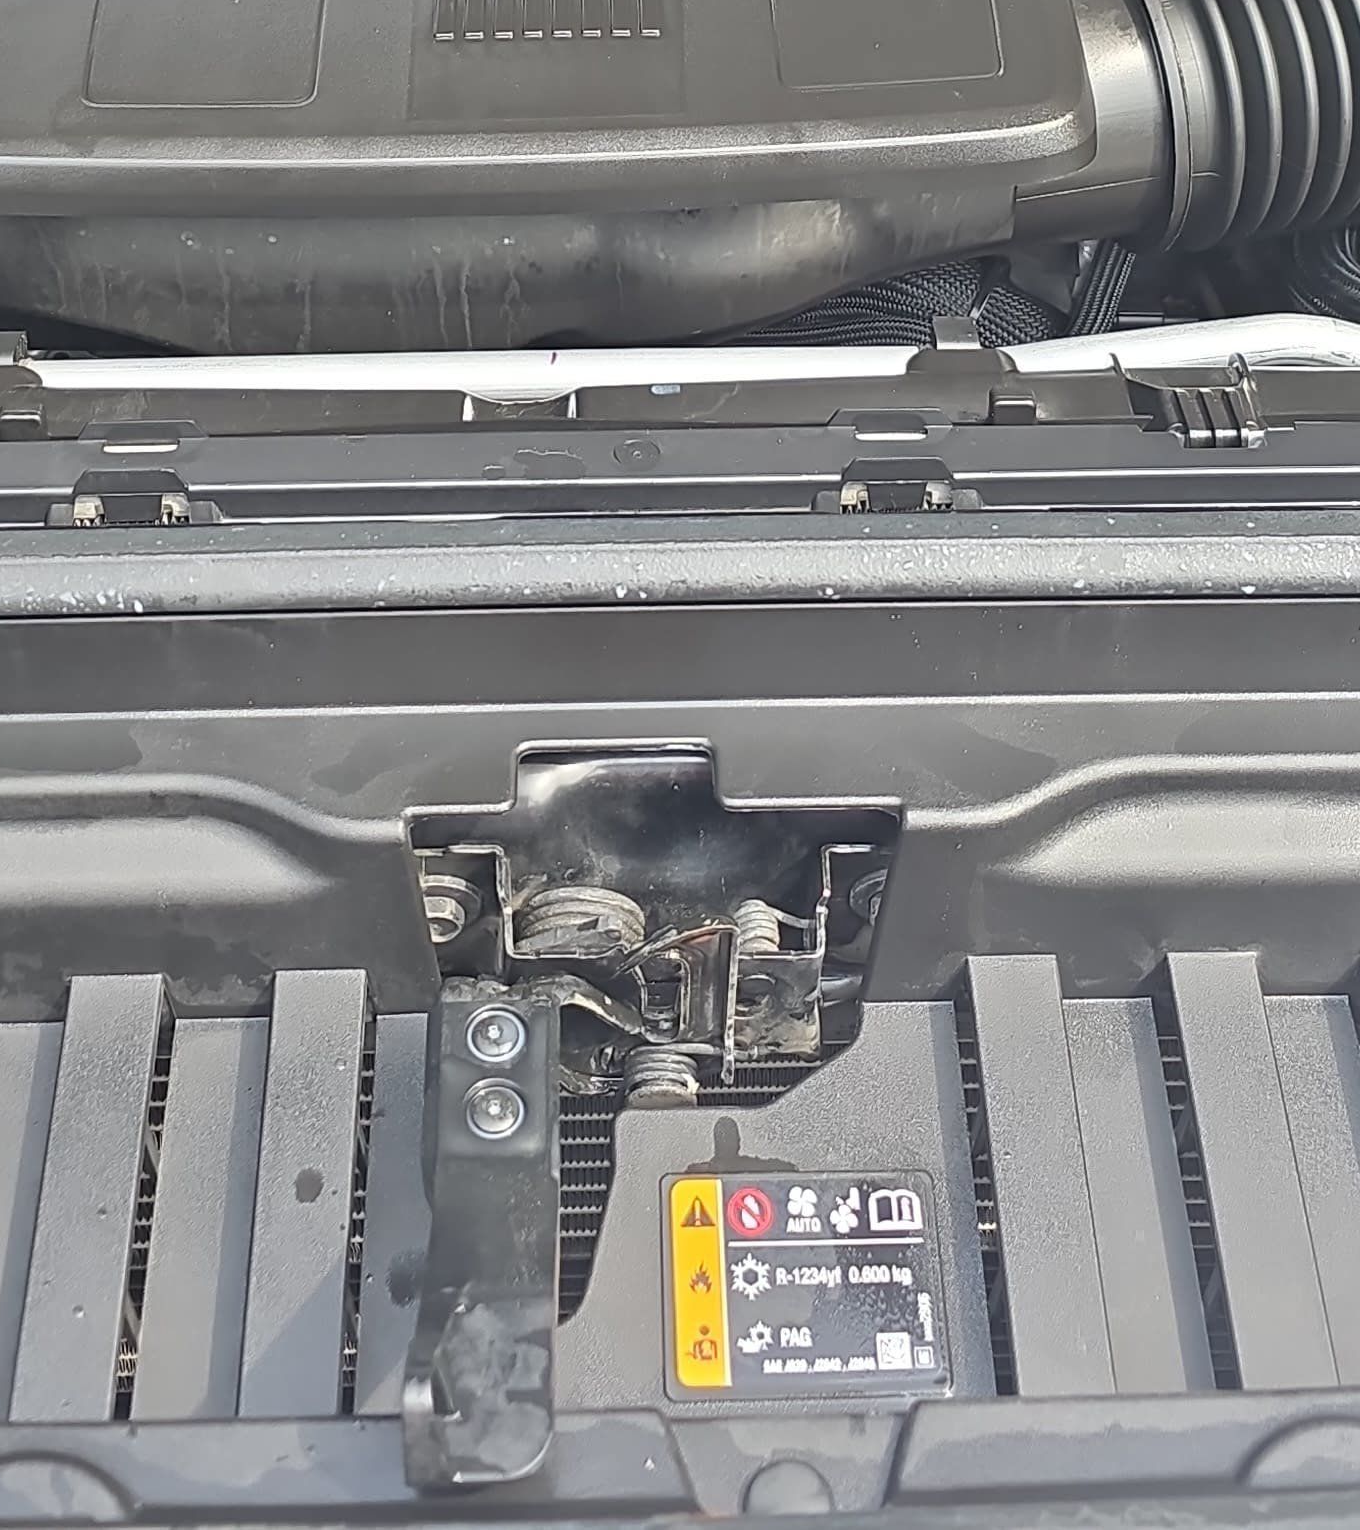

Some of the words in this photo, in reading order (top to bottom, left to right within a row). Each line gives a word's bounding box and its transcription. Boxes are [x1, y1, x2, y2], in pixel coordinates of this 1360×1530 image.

[786, 1217, 821, 1233] AUTO
[775, 1266, 842, 1288] R-1234yf
[891, 1265, 913, 1286] kg
[780, 1327, 813, 1347] PAG
